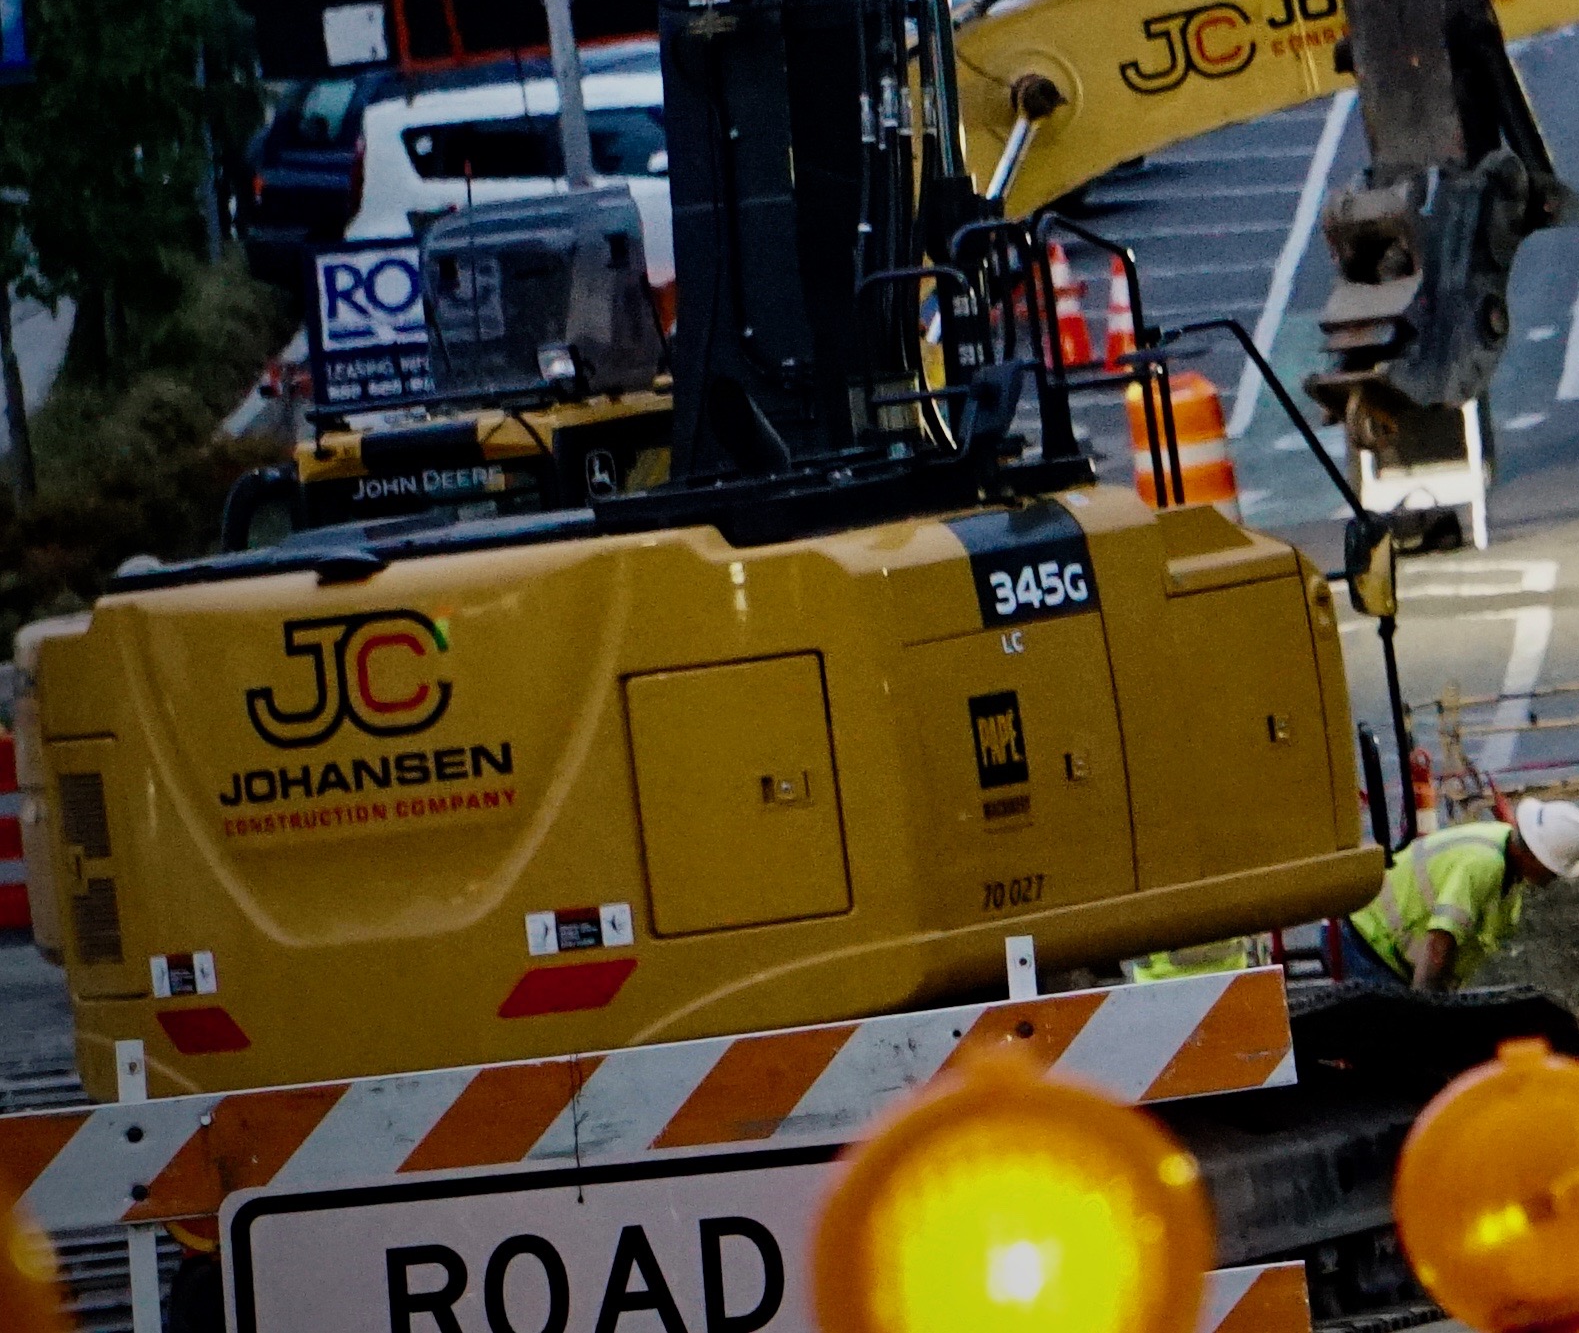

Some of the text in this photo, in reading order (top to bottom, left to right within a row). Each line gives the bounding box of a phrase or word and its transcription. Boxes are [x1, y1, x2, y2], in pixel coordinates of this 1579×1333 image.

[1119, 2, 1257, 96] JC
[352, 474, 417, 501] JOHN
[989, 560, 1089, 615] 345G
[1001, 630, 1025, 654] LC
[245, 608, 453, 749] JC
[218, 742, 515, 807] JOHANSEN
[224, 789, 517, 838] CONSTRUCTION COMPANY
[386, 1216, 785, 1333] ROAD
